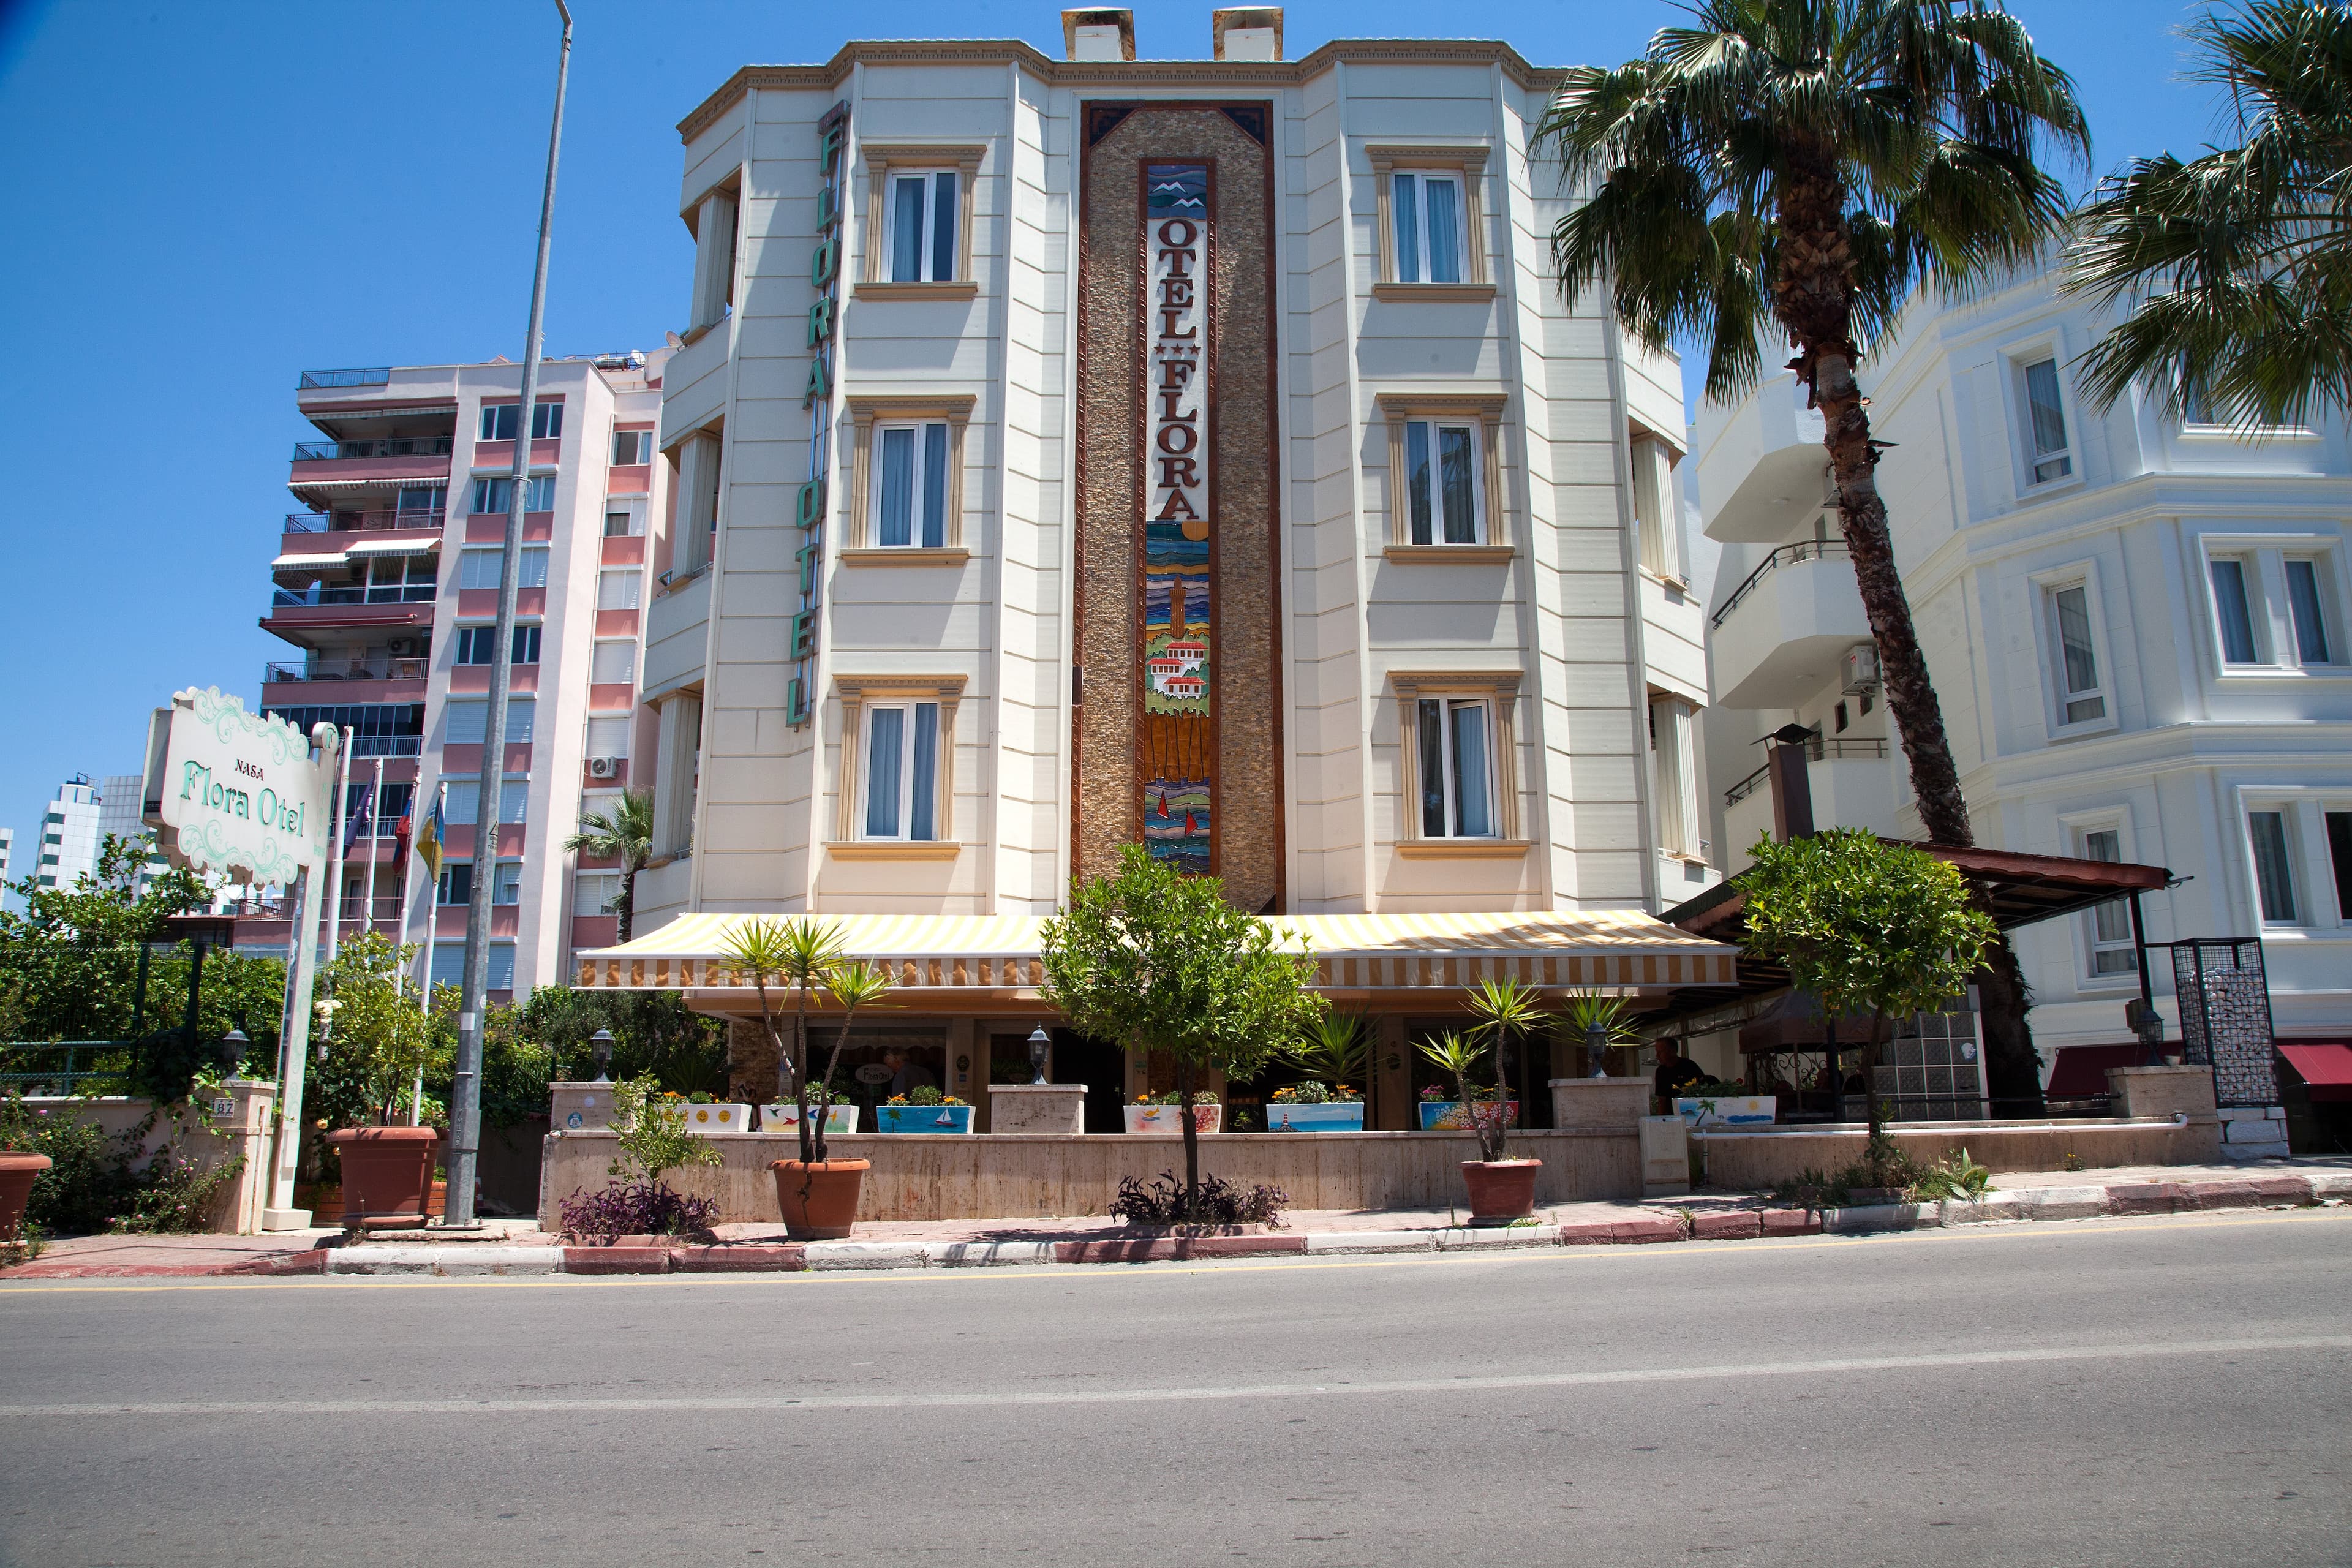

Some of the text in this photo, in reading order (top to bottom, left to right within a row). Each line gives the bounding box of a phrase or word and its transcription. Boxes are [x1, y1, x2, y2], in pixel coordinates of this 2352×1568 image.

[1155, 219, 1201, 521] OTEL FLORA
[786, 127, 843, 728] FLORA OTEL
[181, 760, 250, 820] Flora
[258, 788, 306, 837] Otel
[235, 759, 265, 781] NASA
[864, 1068, 878, 1080] Flora
